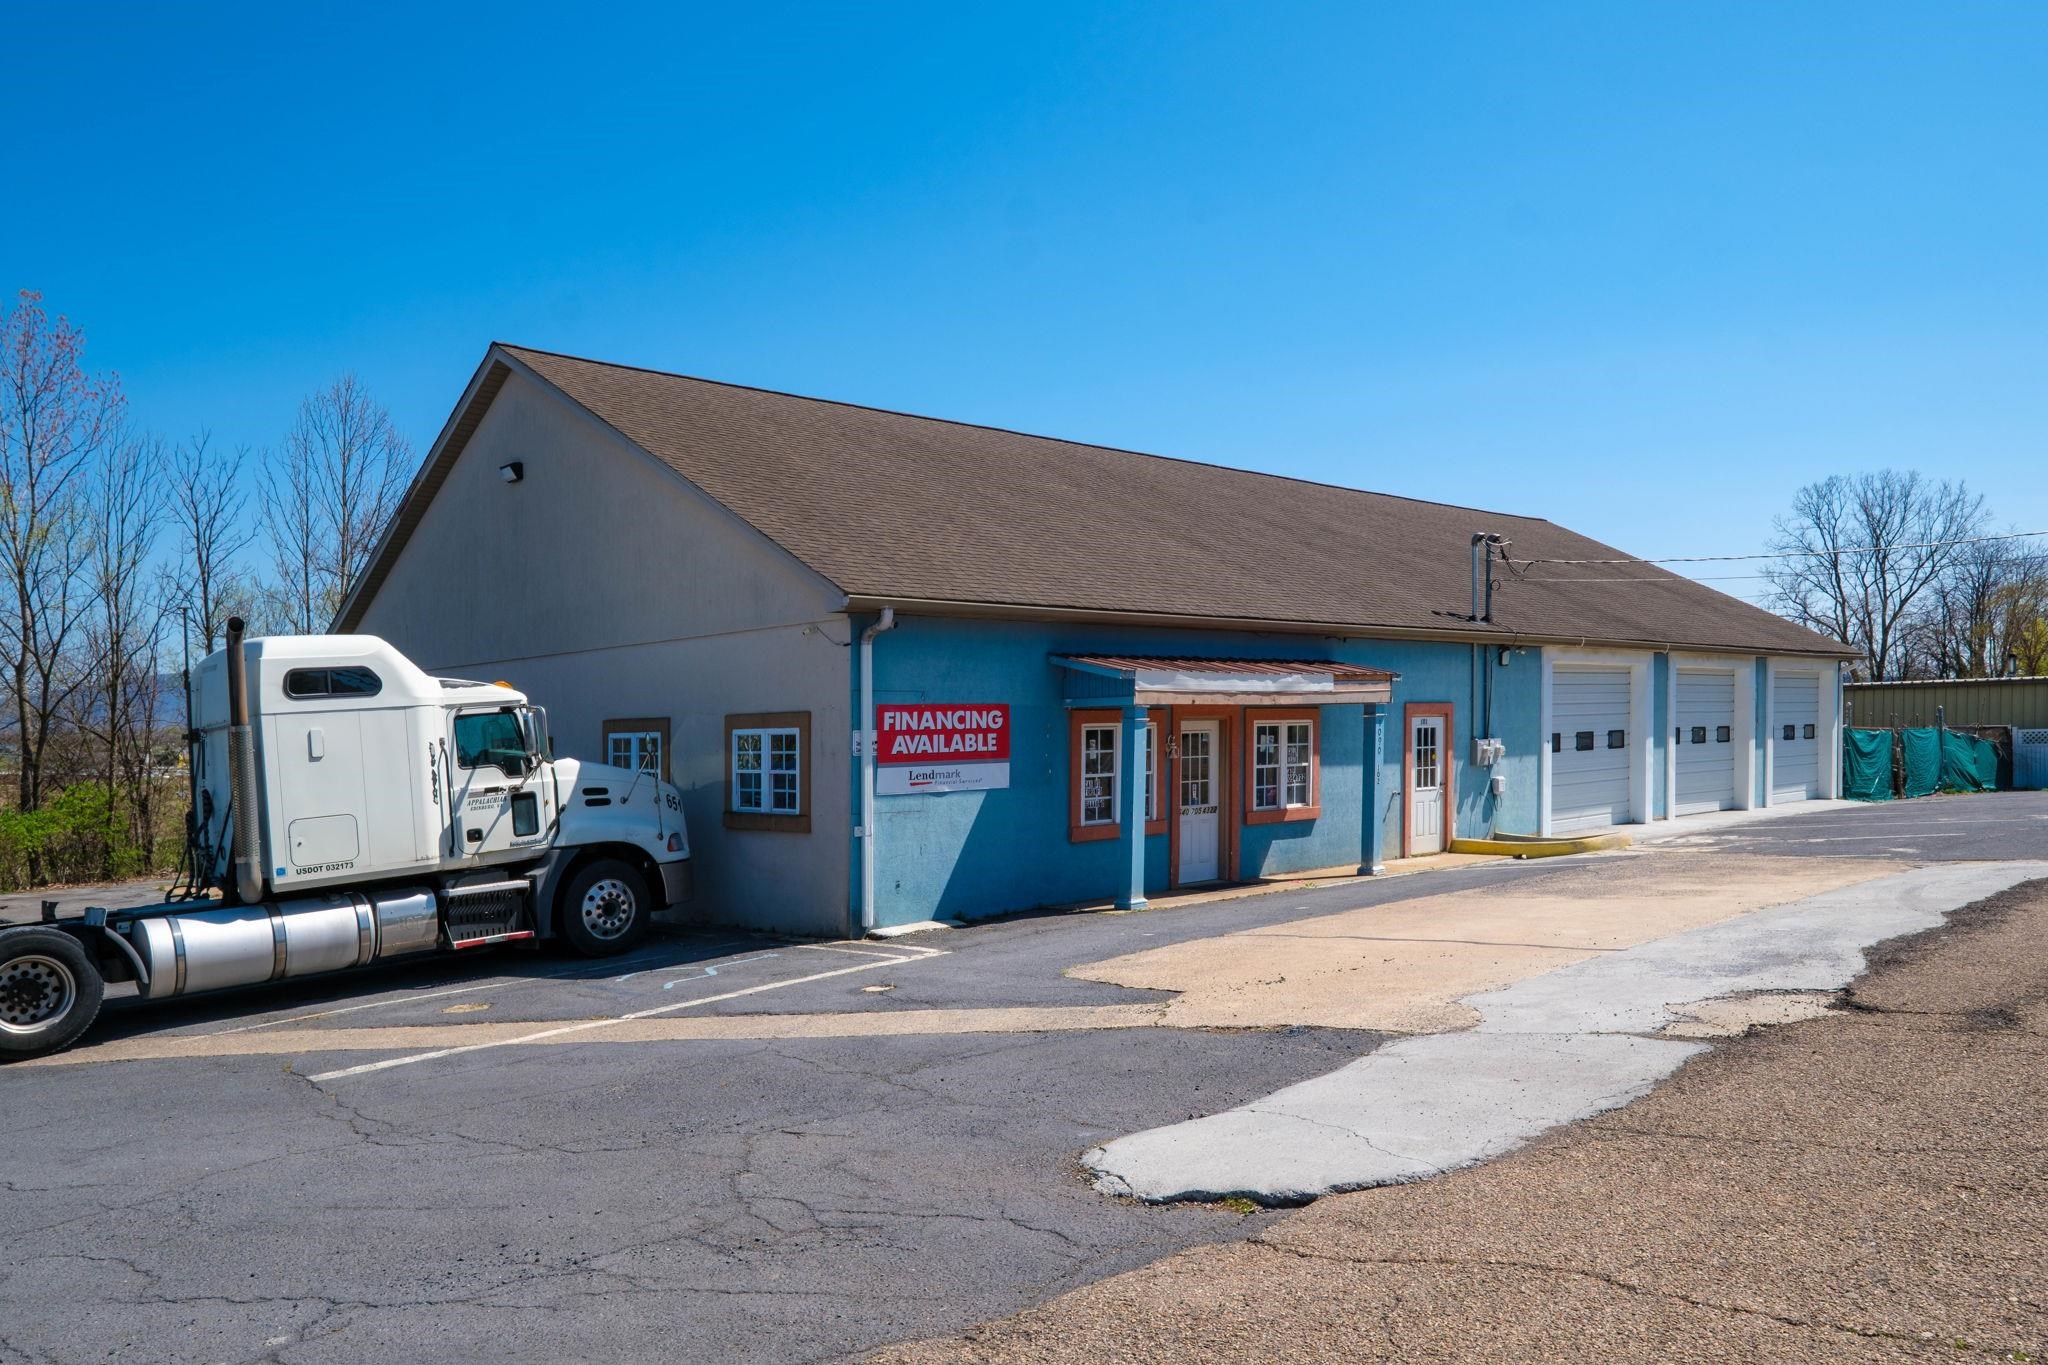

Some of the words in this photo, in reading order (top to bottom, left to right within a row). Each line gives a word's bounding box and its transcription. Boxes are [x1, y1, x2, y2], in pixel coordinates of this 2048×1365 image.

[883, 710, 1003, 731] FINANCING
[891, 733, 998, 755] AVAILABLE
[908, 769, 961, 781] Lendmark
[296, 866, 324, 875] USDOT
[325, 862, 354, 871] 032173
